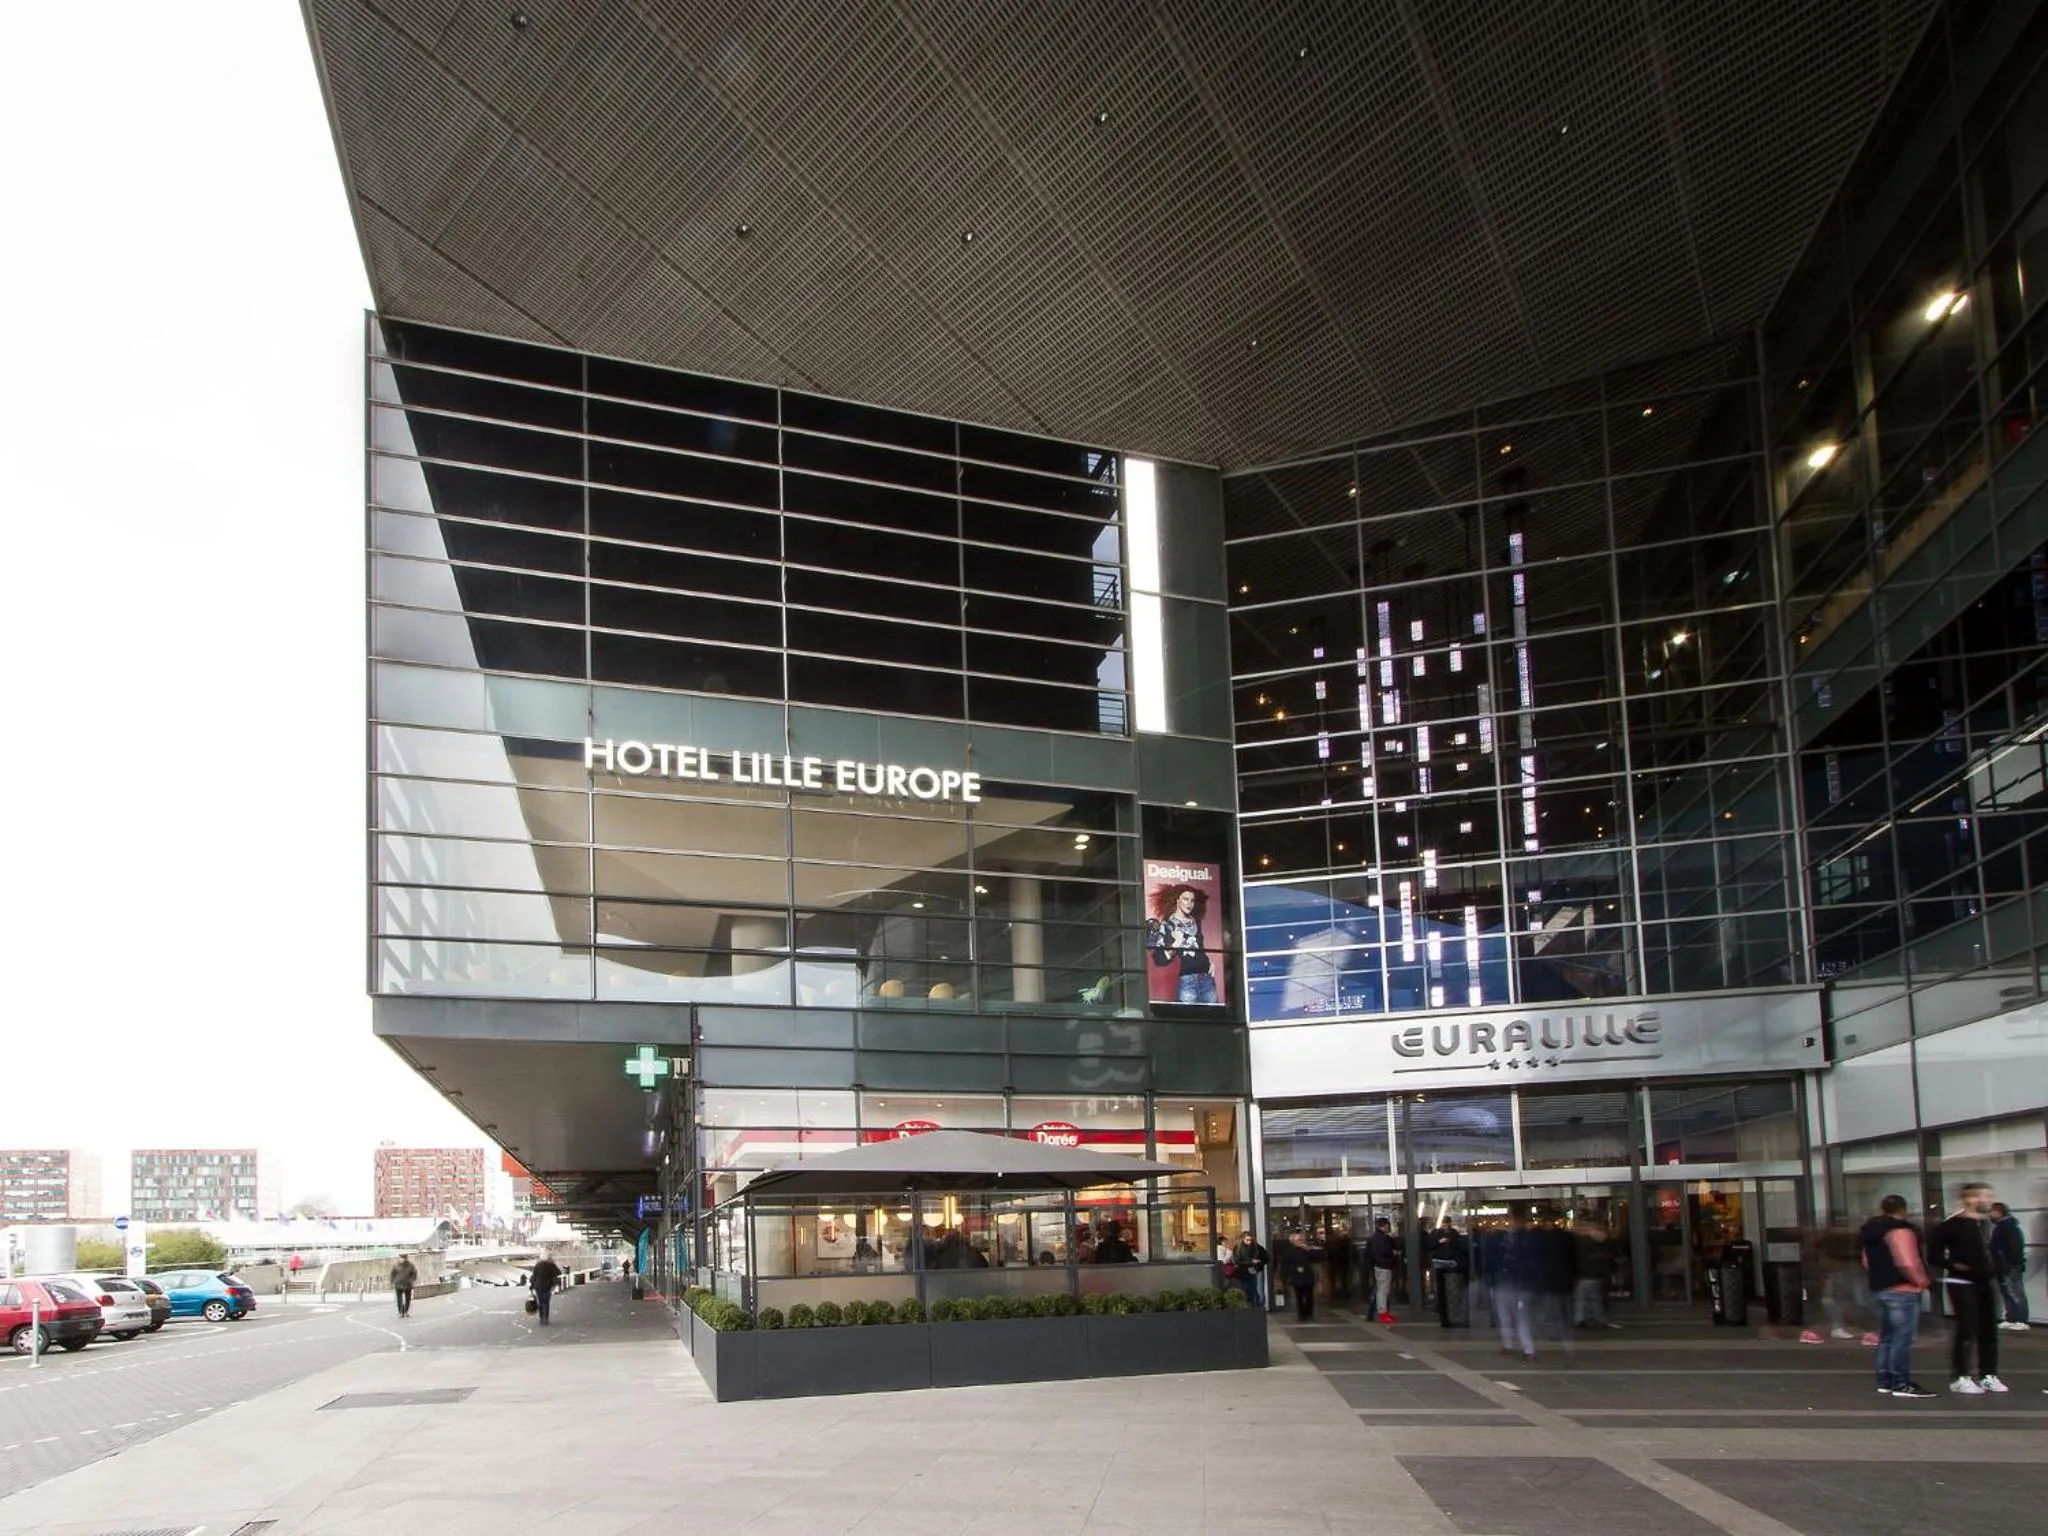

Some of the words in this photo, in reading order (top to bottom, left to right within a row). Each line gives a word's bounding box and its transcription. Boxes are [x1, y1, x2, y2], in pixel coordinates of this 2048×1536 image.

[584, 737, 719, 781] HOTEL
[732, 750, 822, 789] LILLE
[836, 760, 981, 802] EUROPE
[1391, 1011, 1661, 1057] EURALILLE
